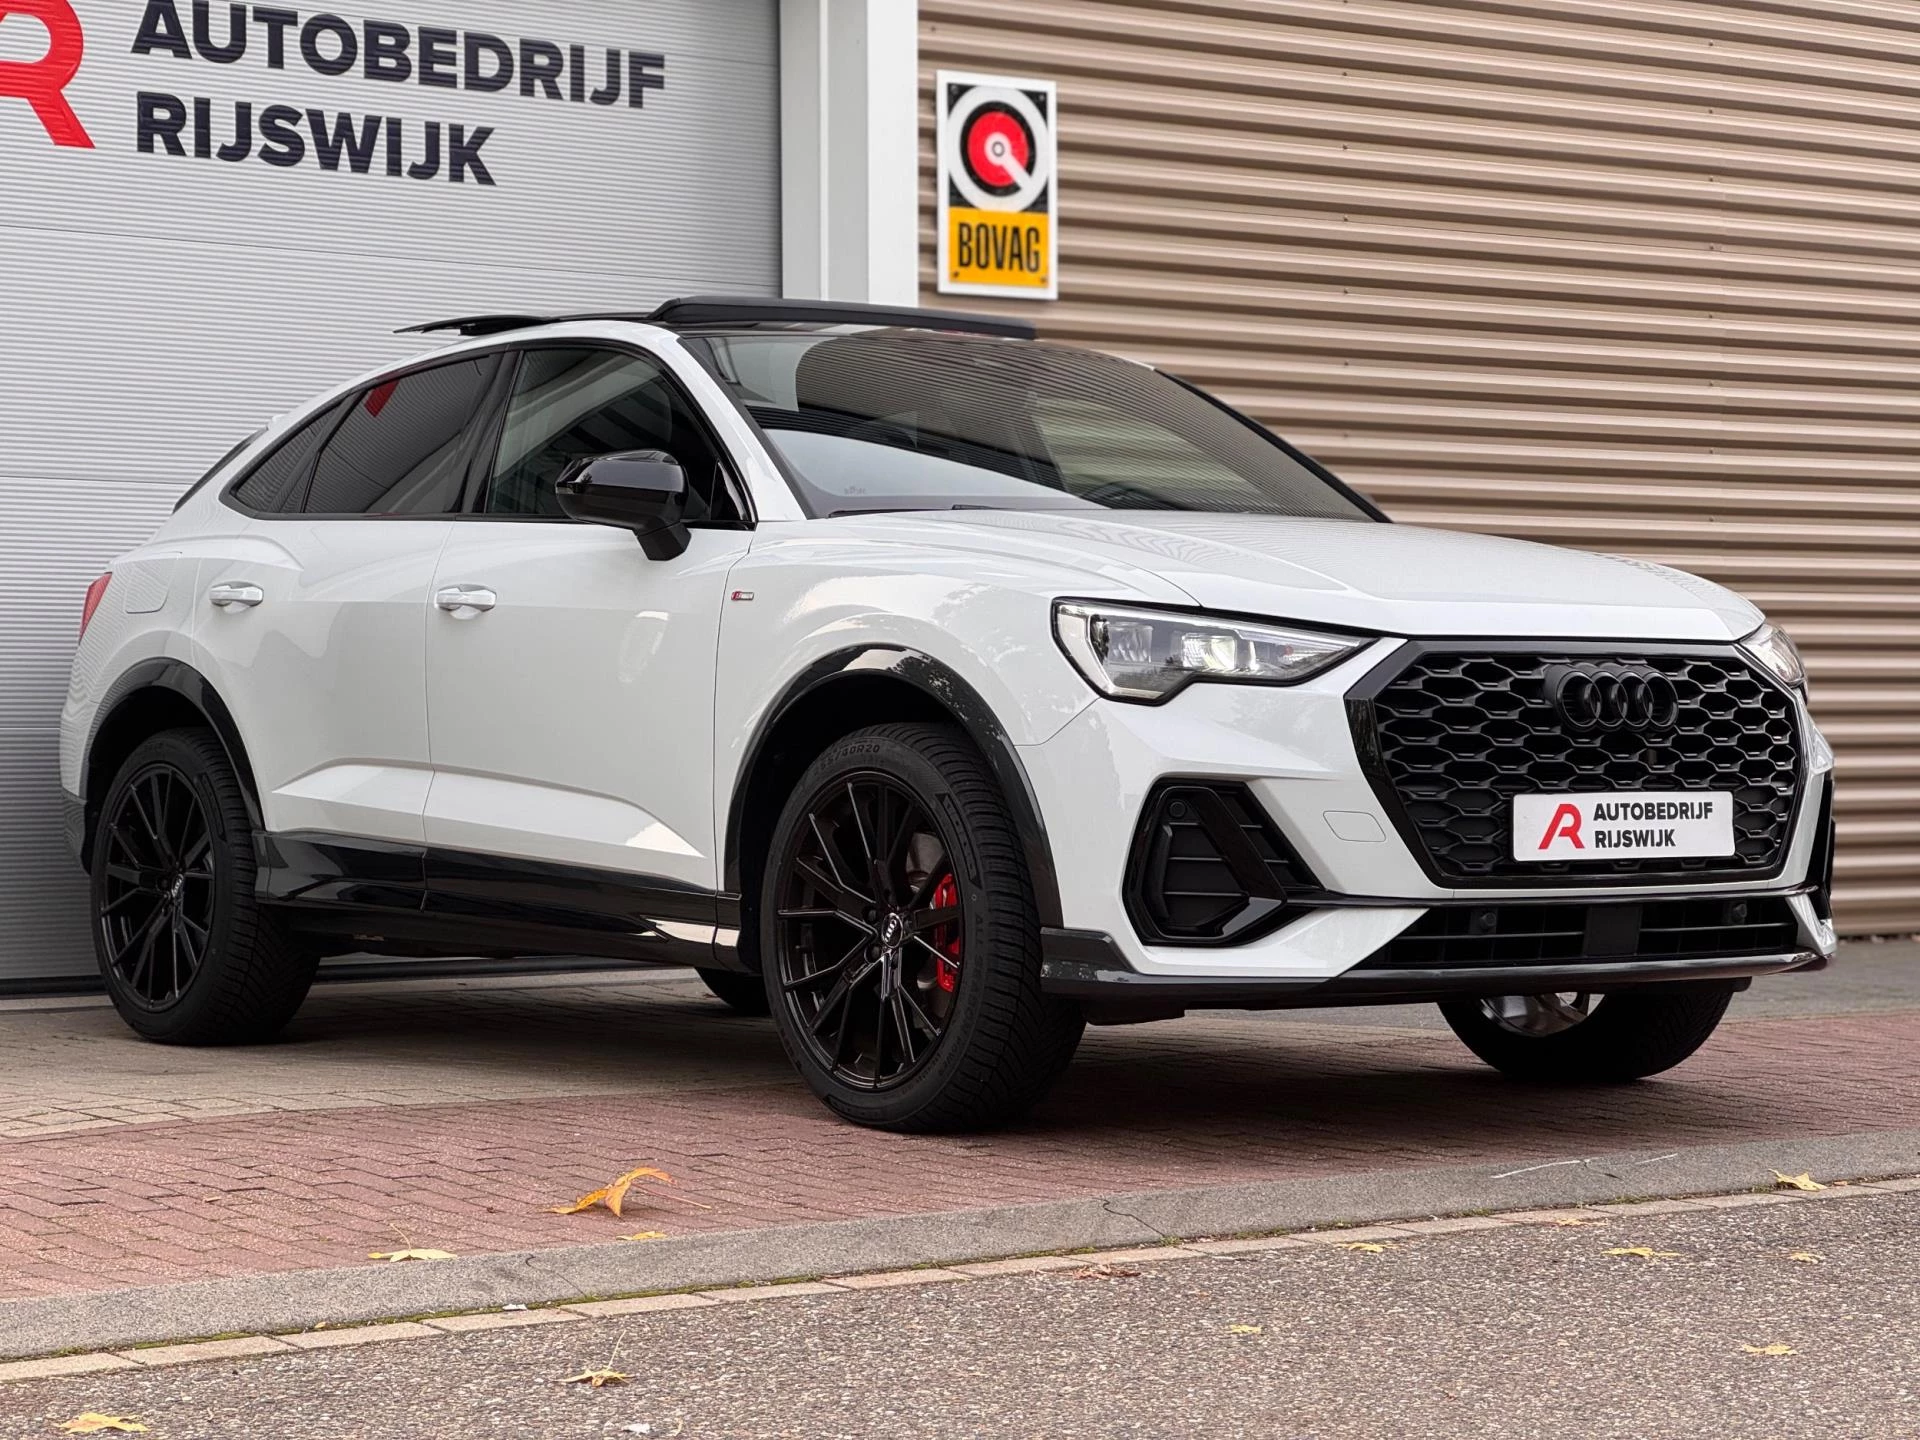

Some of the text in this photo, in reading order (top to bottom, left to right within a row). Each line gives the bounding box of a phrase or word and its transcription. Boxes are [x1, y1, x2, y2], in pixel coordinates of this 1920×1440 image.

[131, 0, 666, 109] AUTOBEDRIJF
[136, 91, 497, 186] RIJSWIJK
[958, 221, 1040, 273] BOVAG
[1593, 802, 1713, 821] AUTOBEDRIJF
[1595, 829, 1676, 848] RIJSWIJK
